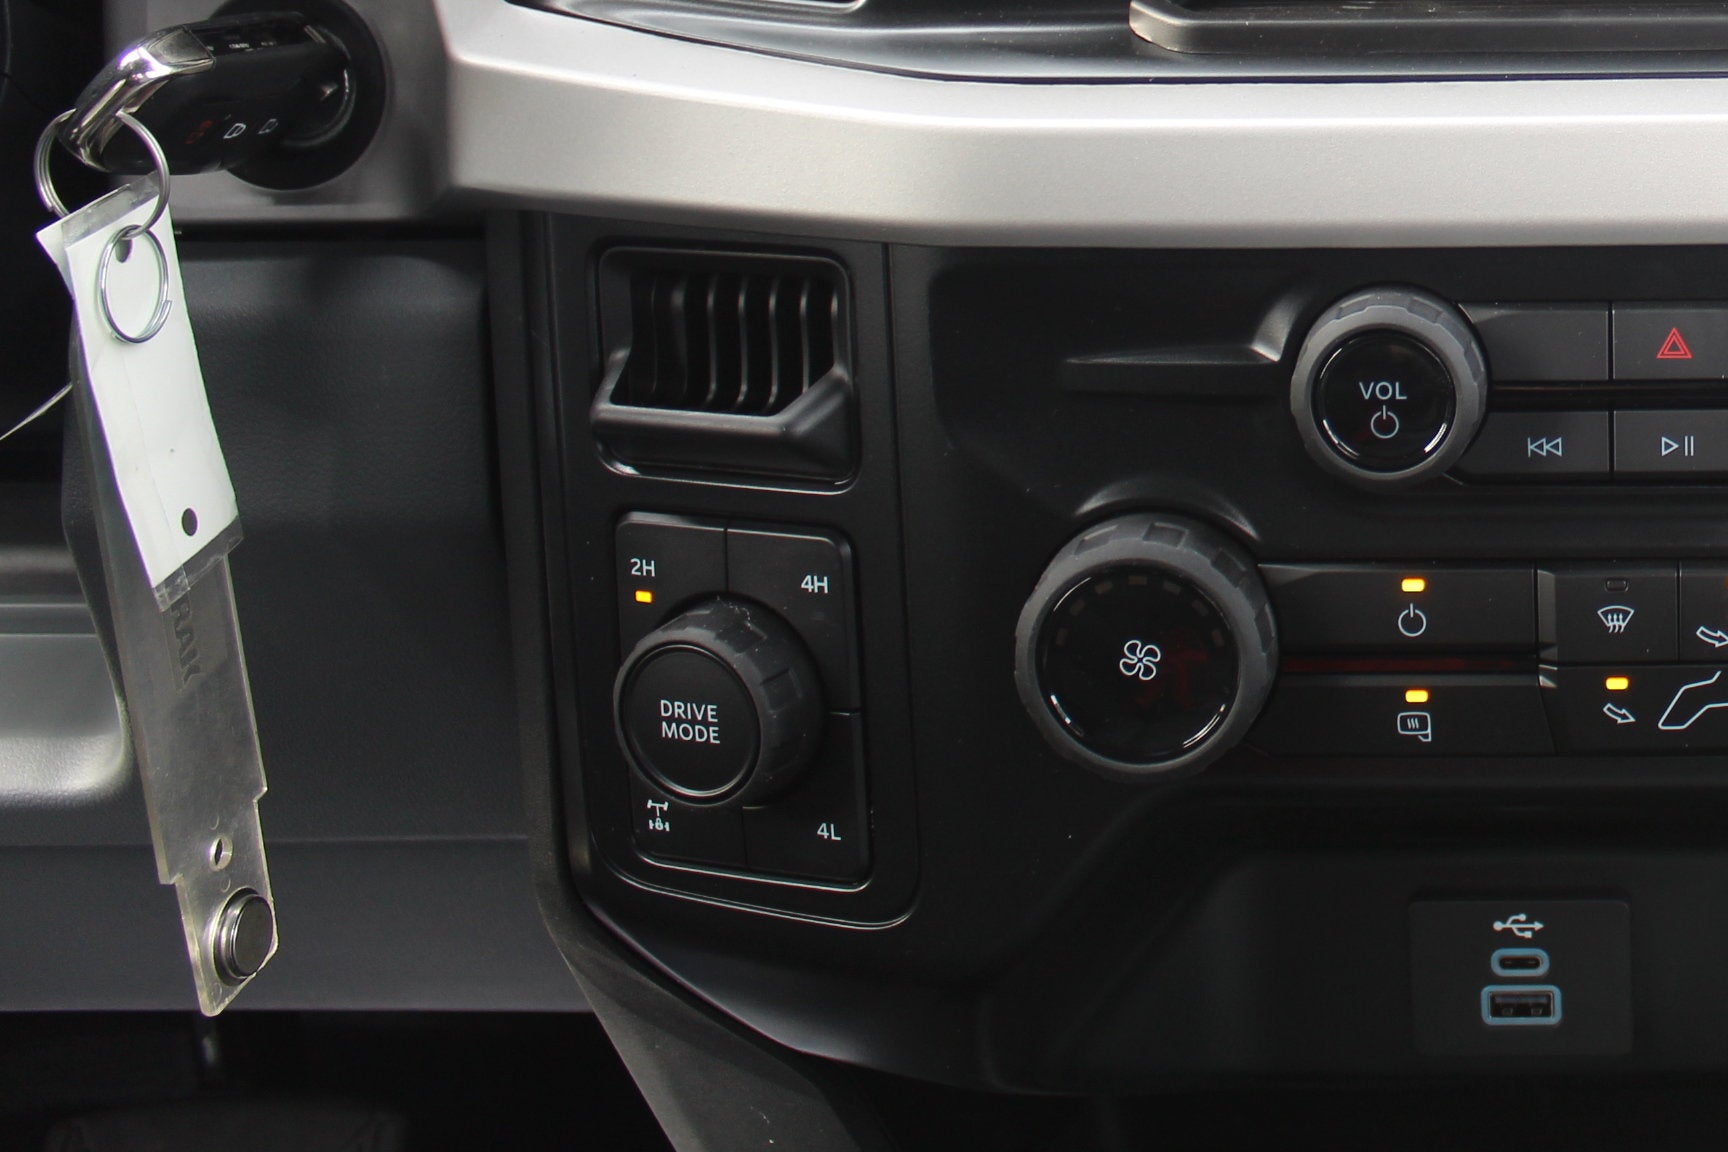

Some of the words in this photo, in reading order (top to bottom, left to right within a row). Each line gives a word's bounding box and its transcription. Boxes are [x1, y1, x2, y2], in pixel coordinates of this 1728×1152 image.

[1358, 381, 1408, 401] VOL
[630, 558, 656, 577] 2H
[800, 574, 829, 594] 4H
[660, 699, 719, 723] DRIVE
[661, 721, 721, 744] MODE
[816, 822, 842, 841] 4L
